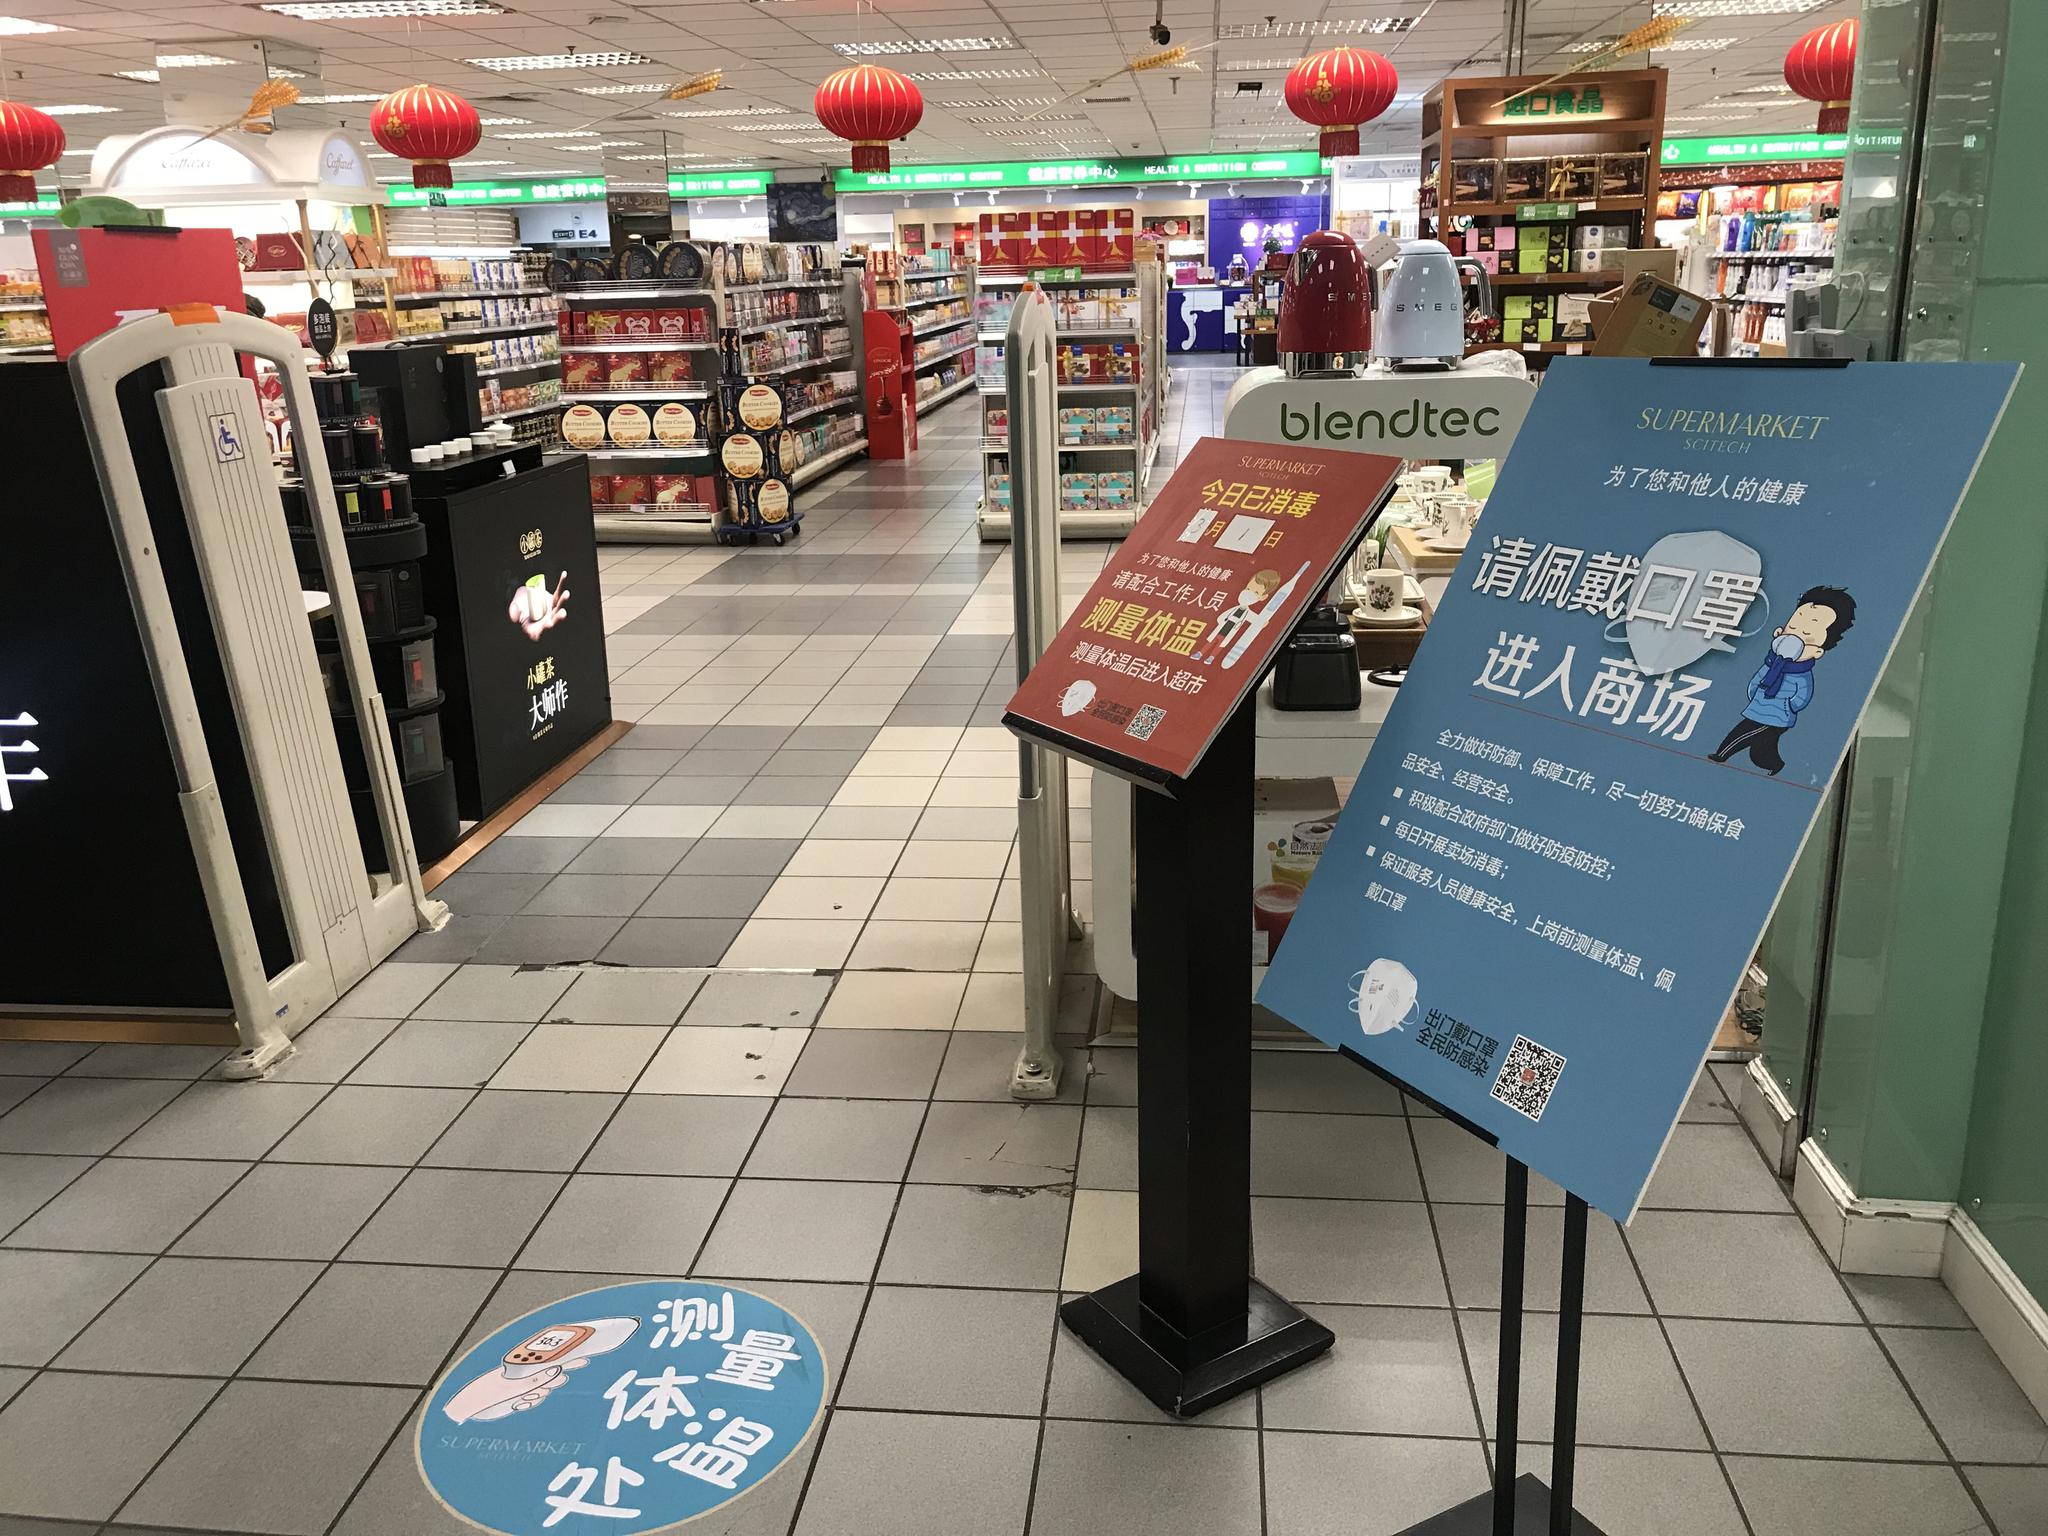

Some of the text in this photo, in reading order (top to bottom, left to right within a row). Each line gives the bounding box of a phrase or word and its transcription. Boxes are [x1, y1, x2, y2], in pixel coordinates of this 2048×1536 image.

[1144, 164, 1179, 176] HEALTH
[578, 229, 597, 239] E4
[1395, 302, 1458, 312] SMEG
[1281, 399, 1500, 441] blendtec
[1636, 407, 1830, 440] SUPERMARKET
[1238, 455, 1328, 477] SUPERMARKET
[1683, 437, 1751, 454] SCITECH
[1201, 479, 1320, 519] 今日已消毒
[1604, 464, 1809, 506] 为了您和他人的健康
[1137, 552, 1234, 583] 为了您和他人的健康
[1471, 535, 1763, 640] 请佩戴口罩
[1111, 569, 1229, 612] 请配合工作人员
[1080, 596, 1207, 656] 测量体温
[1070, 640, 1208, 696] 测量体温后进入超市
[1472, 631, 1713, 742] 进入商场
[528, 678, 569, 731] 大师作
[1401, 752, 1516, 805] 品安全、经营安全。
[1364, 881, 1407, 913] 戴口罩
[1415, 1026, 1492, 1078] 全民防感染
[1424, 1007, 1500, 1059] 出门戴口罩
[438, 1436, 586, 1455] SUPERMARKET
